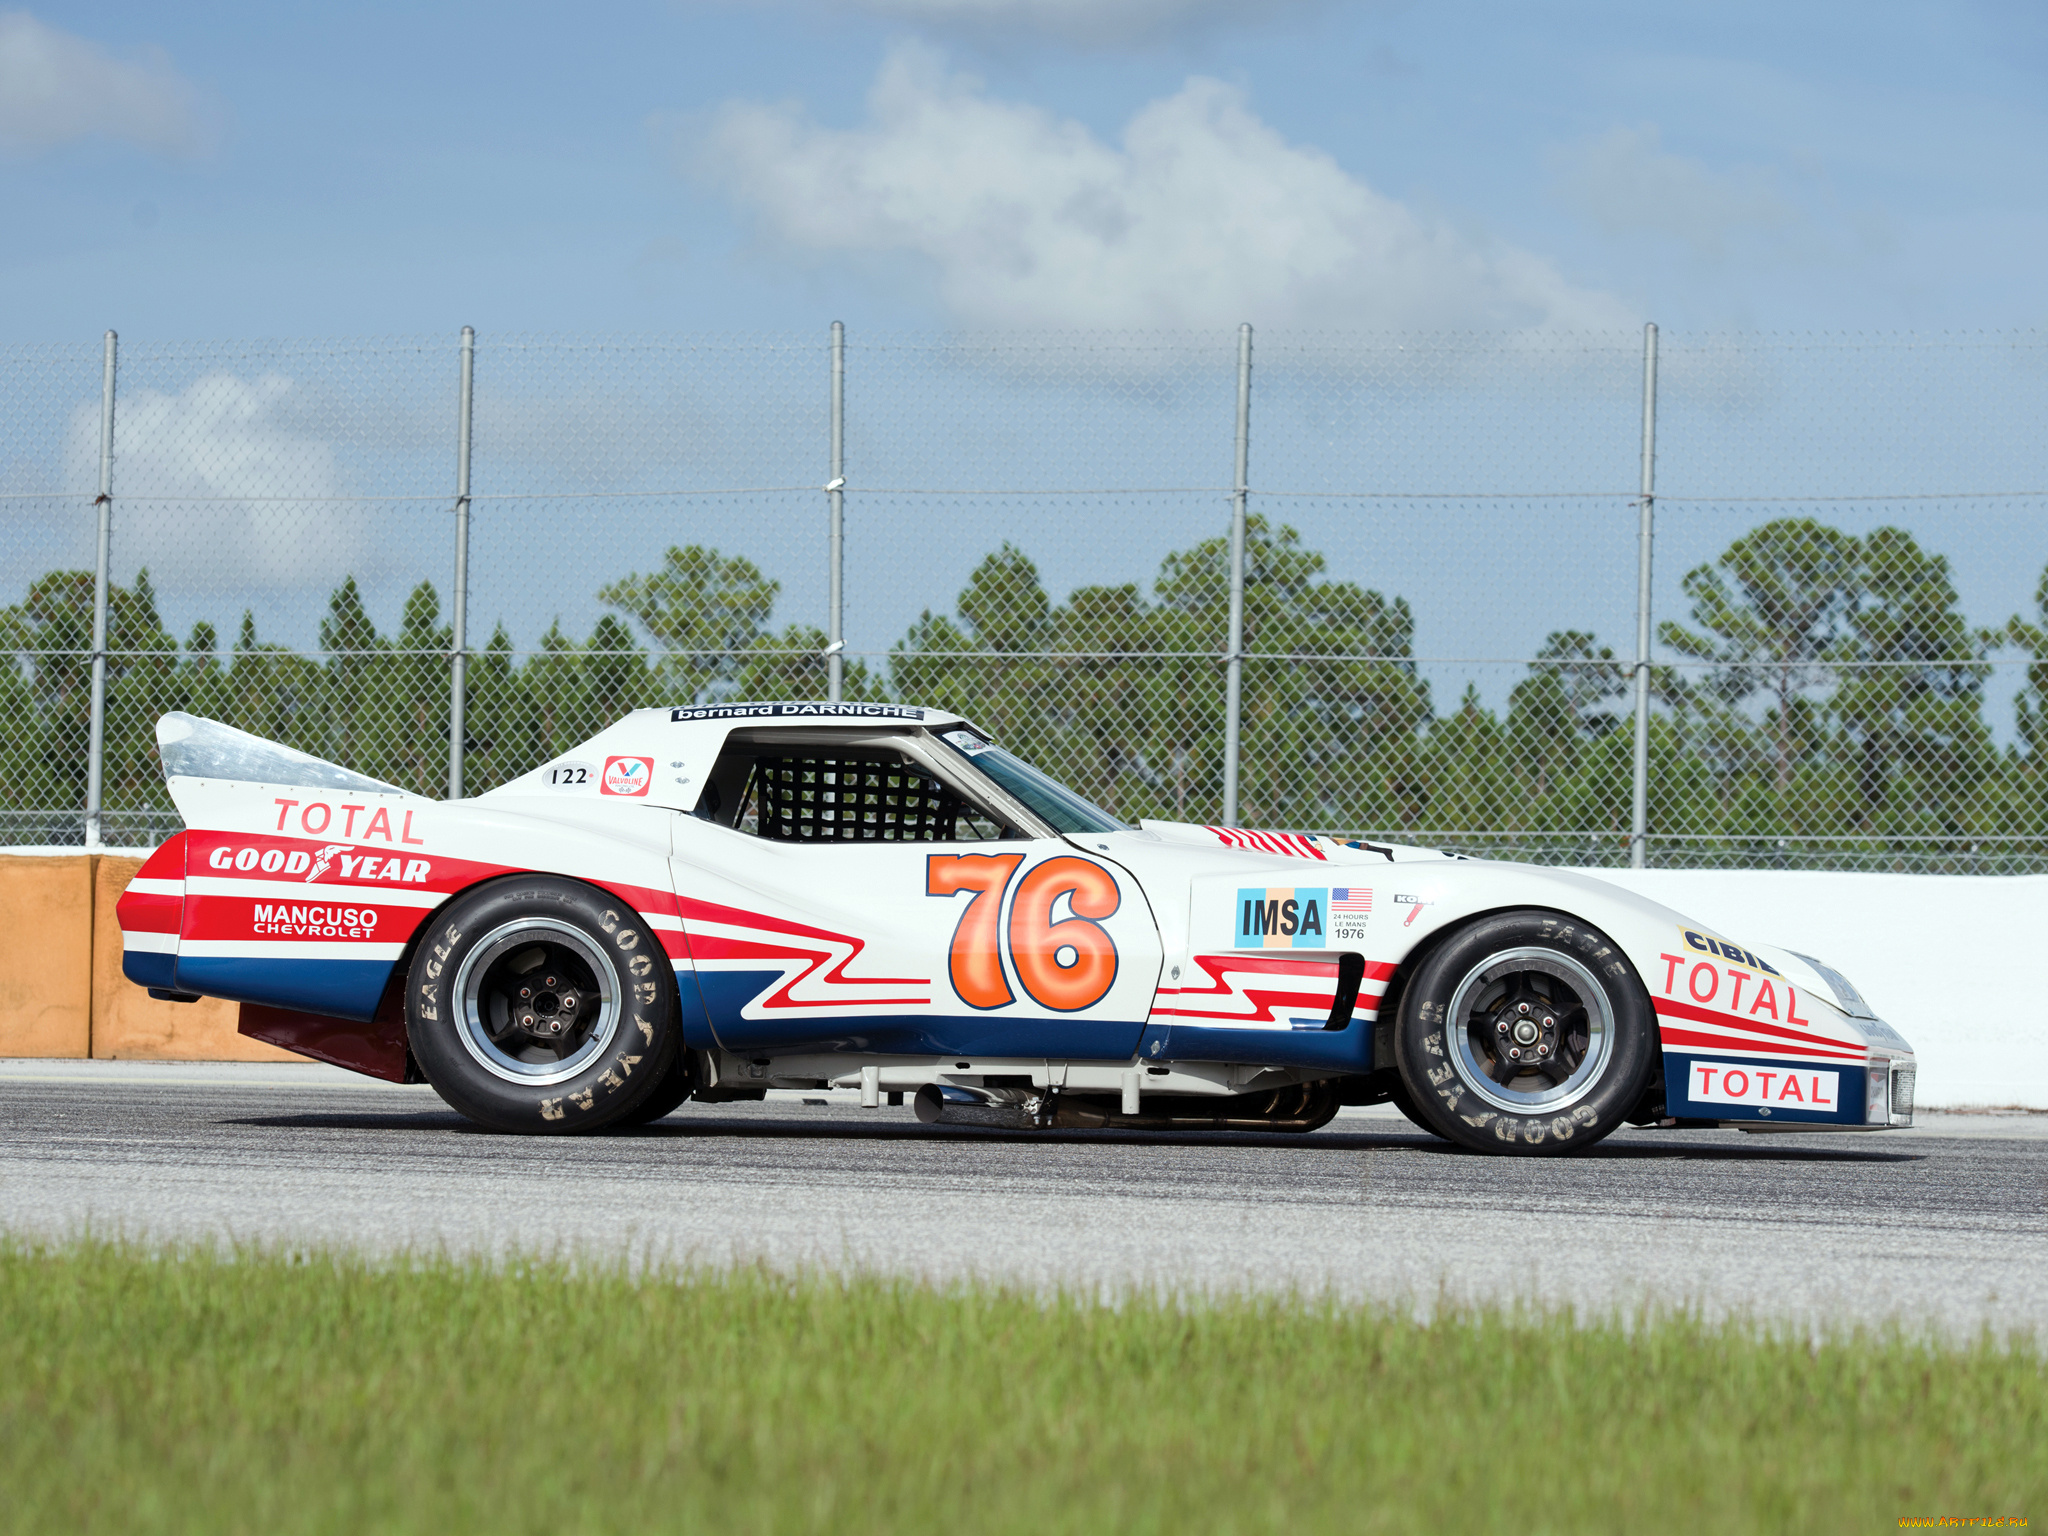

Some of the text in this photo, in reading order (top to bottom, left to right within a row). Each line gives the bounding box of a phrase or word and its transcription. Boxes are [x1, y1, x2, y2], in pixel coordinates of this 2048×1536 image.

[677, 704, 773, 720] bernard
[781, 705, 918, 718] DARNICHE
[551, 768, 587, 785] 122
[608, 775, 643, 787] VALVOLINE
[274, 797, 425, 846] TOTAL
[209, 846, 432, 883] GOOD YEAR
[253, 903, 378, 928] MANCUSO
[1242, 898, 1323, 936] IMSA
[1397, 895, 1432, 904] KON
[253, 923, 375, 939] CHEVROLET
[925, 852, 1122, 1013] 76
[1334, 928, 1365, 939] 1976
[421, 923, 462, 1022] EAGLE
[598, 908, 656, 1005] GOOD
[1659, 952, 1809, 1027] TOTAL
[1696, 1067, 1831, 1104] TOTAL
[1495, 1104, 1598, 1144] GOOD
